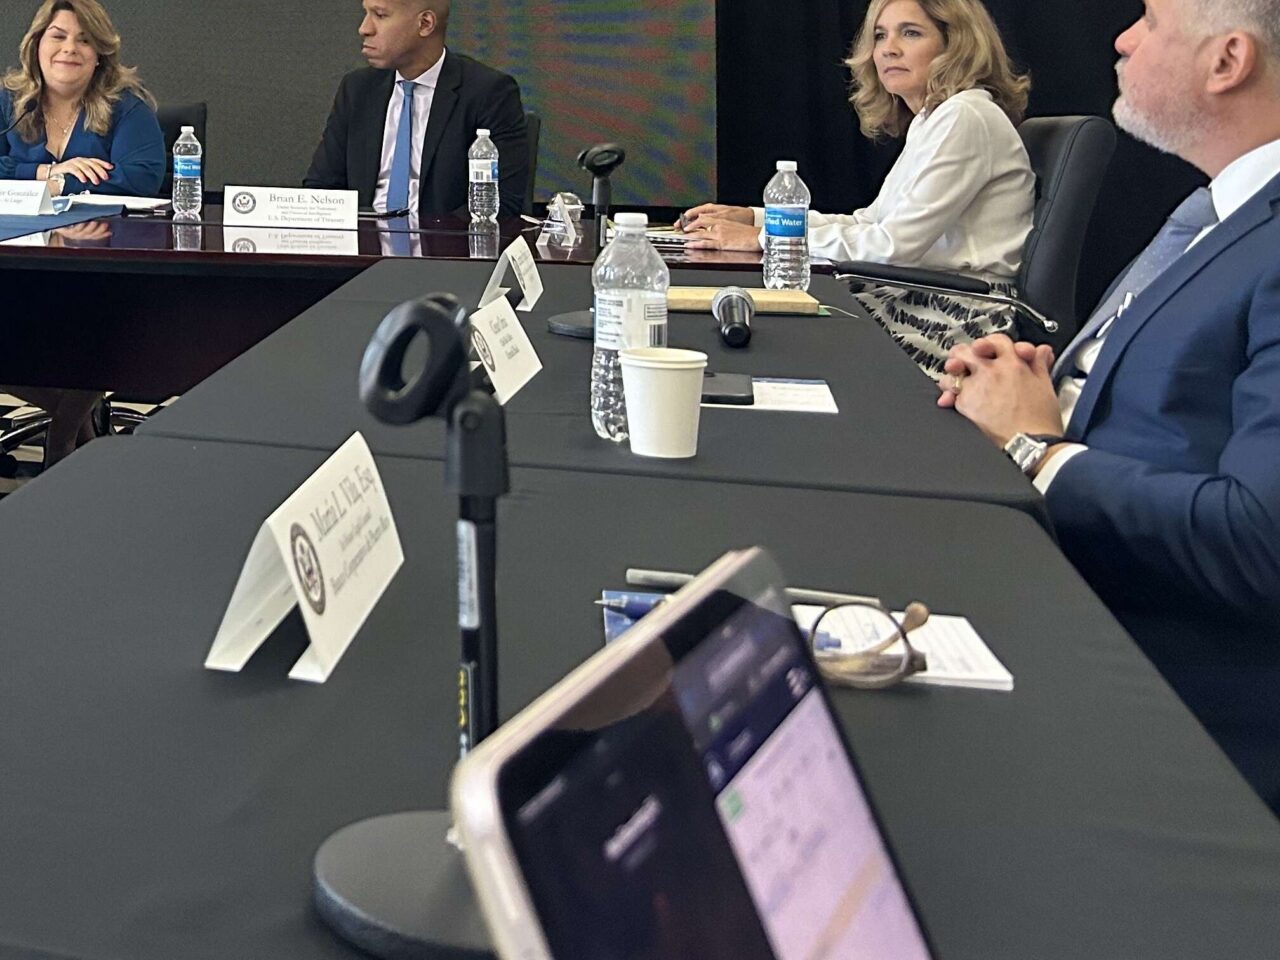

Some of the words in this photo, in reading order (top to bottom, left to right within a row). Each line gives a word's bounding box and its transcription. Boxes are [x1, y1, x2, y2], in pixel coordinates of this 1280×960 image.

[269, 193, 294, 203] Brian
[297, 194, 308, 204] E.
[311, 194, 345, 205] Nelson
[781, 218, 803, 227] Water
